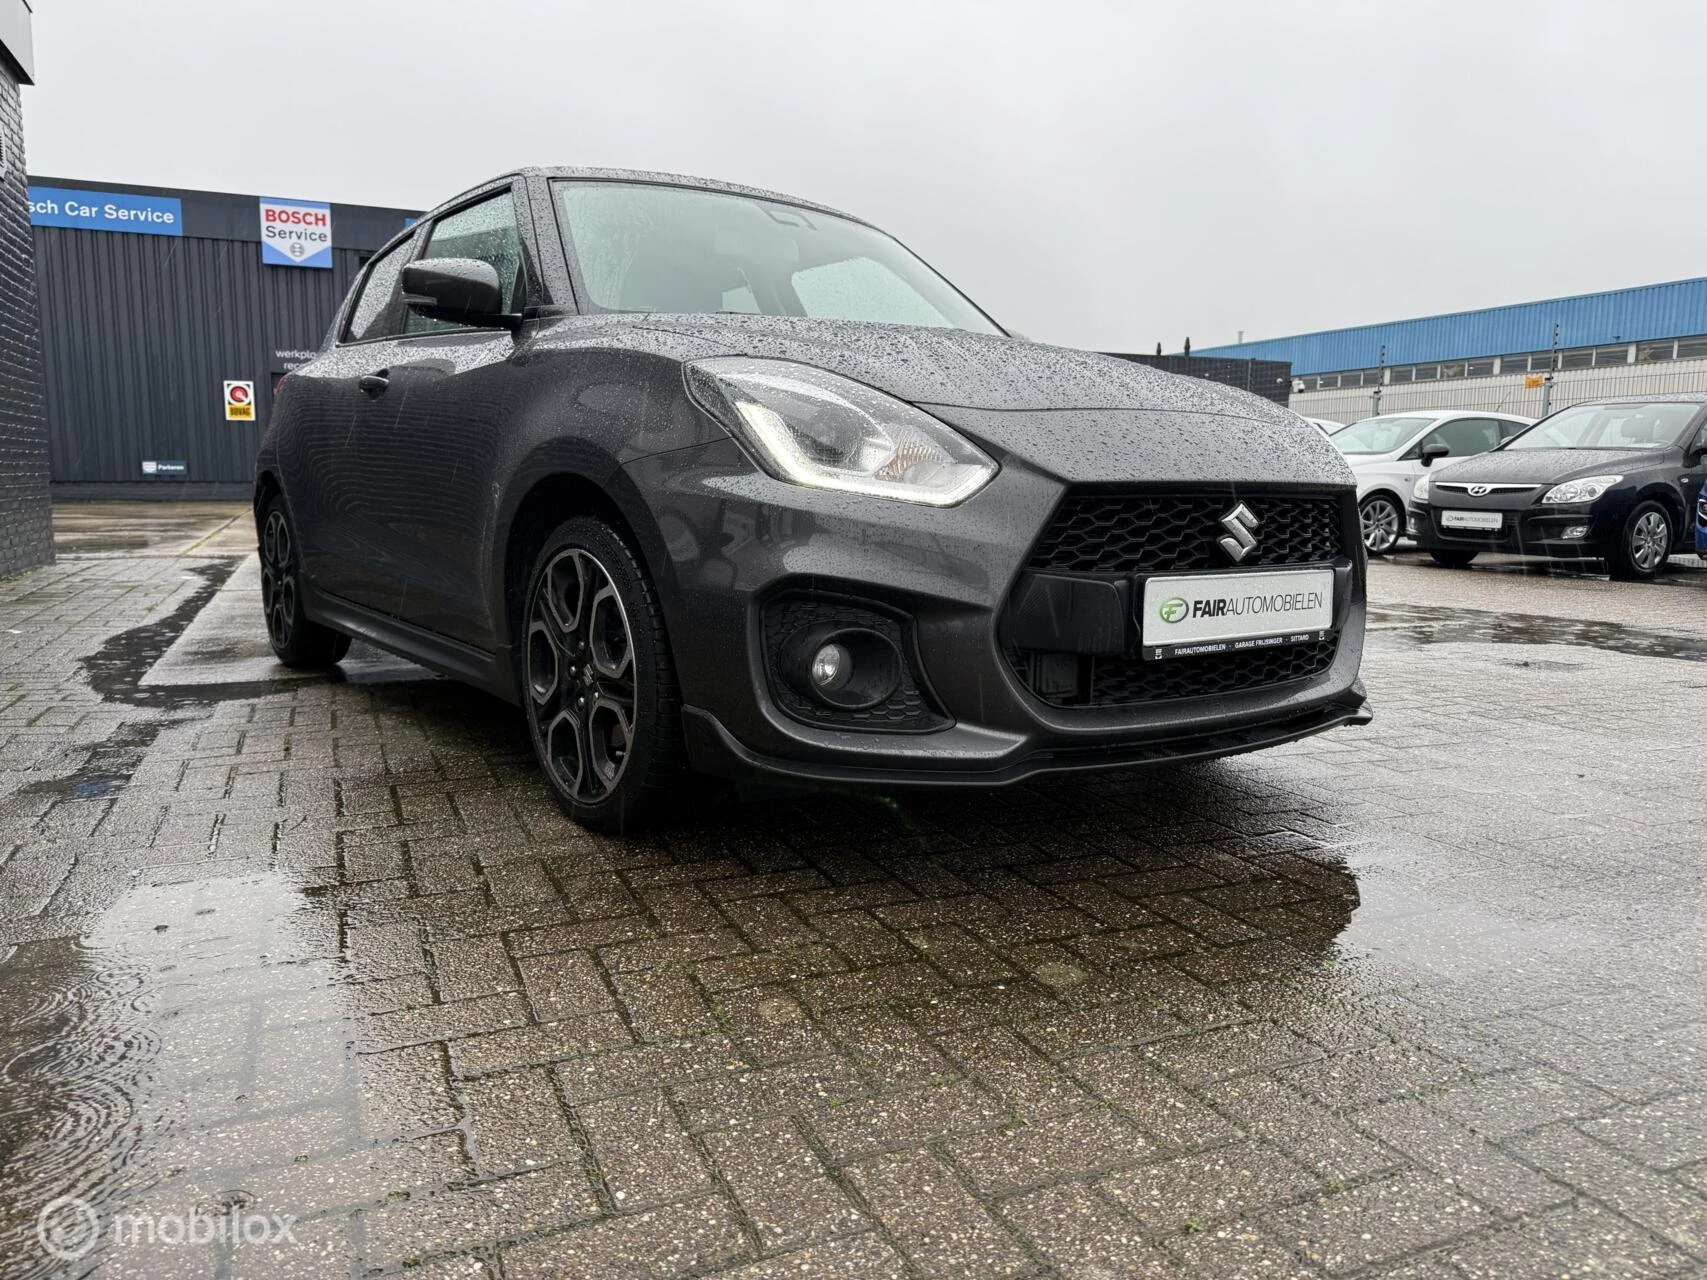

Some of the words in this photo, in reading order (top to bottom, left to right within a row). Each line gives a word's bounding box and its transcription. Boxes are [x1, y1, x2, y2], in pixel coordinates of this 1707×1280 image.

[28, 199, 58, 214] sch
[65, 201, 98, 217] Car
[104, 204, 174, 224] Service
[265, 208, 326, 227] BOSCH
[265, 225, 327, 242] Service
[275, 350, 316, 360] werkpla
[1192, 591, 1323, 619] FAIRAUTOMOBIELEN
[1174, 643, 1226, 655] FAIRAUTOMOBIELEN
[1235, 640, 1255, 648] GARAGE
[1290, 634, 1310, 642] SITTARD
